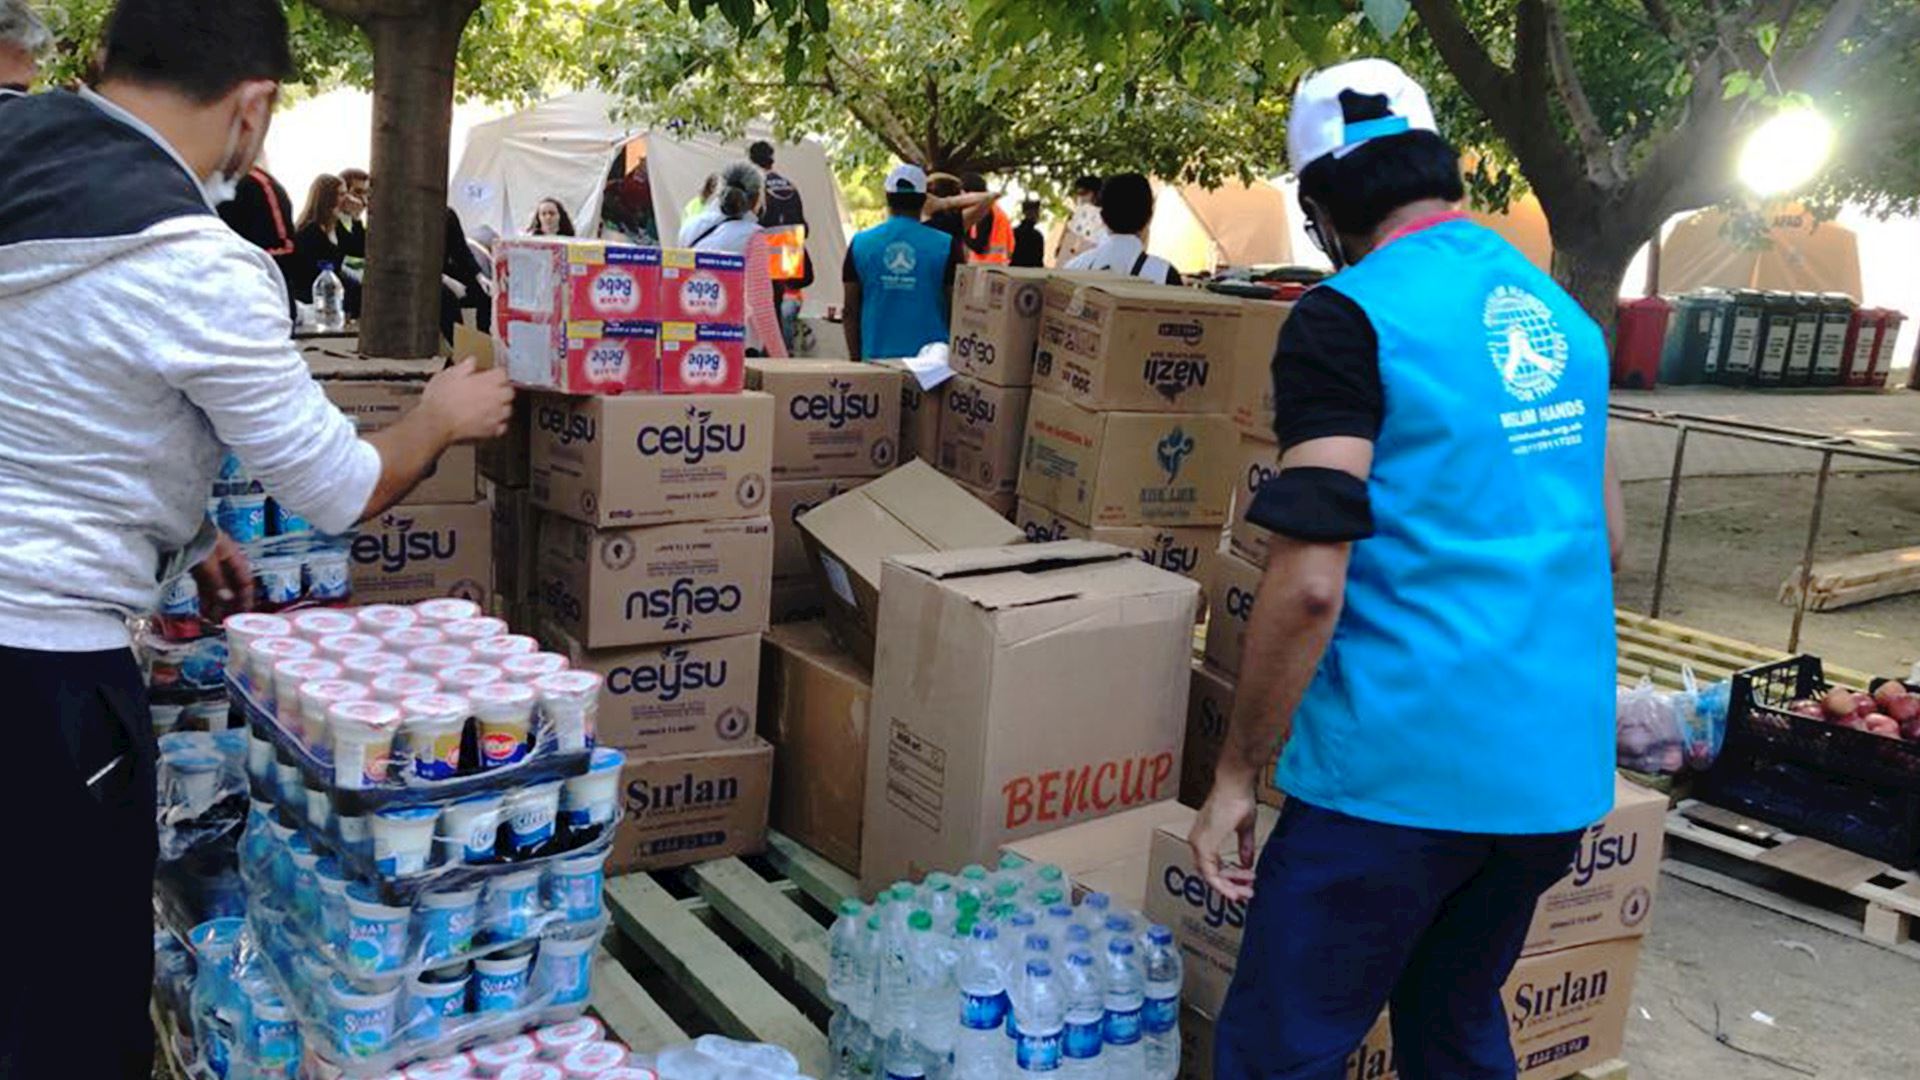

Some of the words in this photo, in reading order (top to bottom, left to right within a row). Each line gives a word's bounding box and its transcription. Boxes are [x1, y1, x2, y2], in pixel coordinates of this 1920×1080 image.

[596, 276, 633, 297] Bebe
[687, 279, 720, 300] Bebe
[591, 350, 625, 368] Bebe
[687, 353, 720, 371] Bebe
[538, 405, 596, 445] ceysu
[790, 387, 880, 429] ceysu
[949, 388, 996, 424] ceysu
[636, 415, 746, 465] ceysu
[352, 525, 456, 573] eysu
[626, 577, 742, 621] ceysu
[606, 655, 727, 702] ceysu
[625, 772, 738, 820] Şırlan
[1002, 751, 1174, 829] BENCUP
[1572, 828, 1638, 887] ysu
[1164, 865, 1245, 928] ceys
[1511, 968, 1608, 1031] Şırlan
